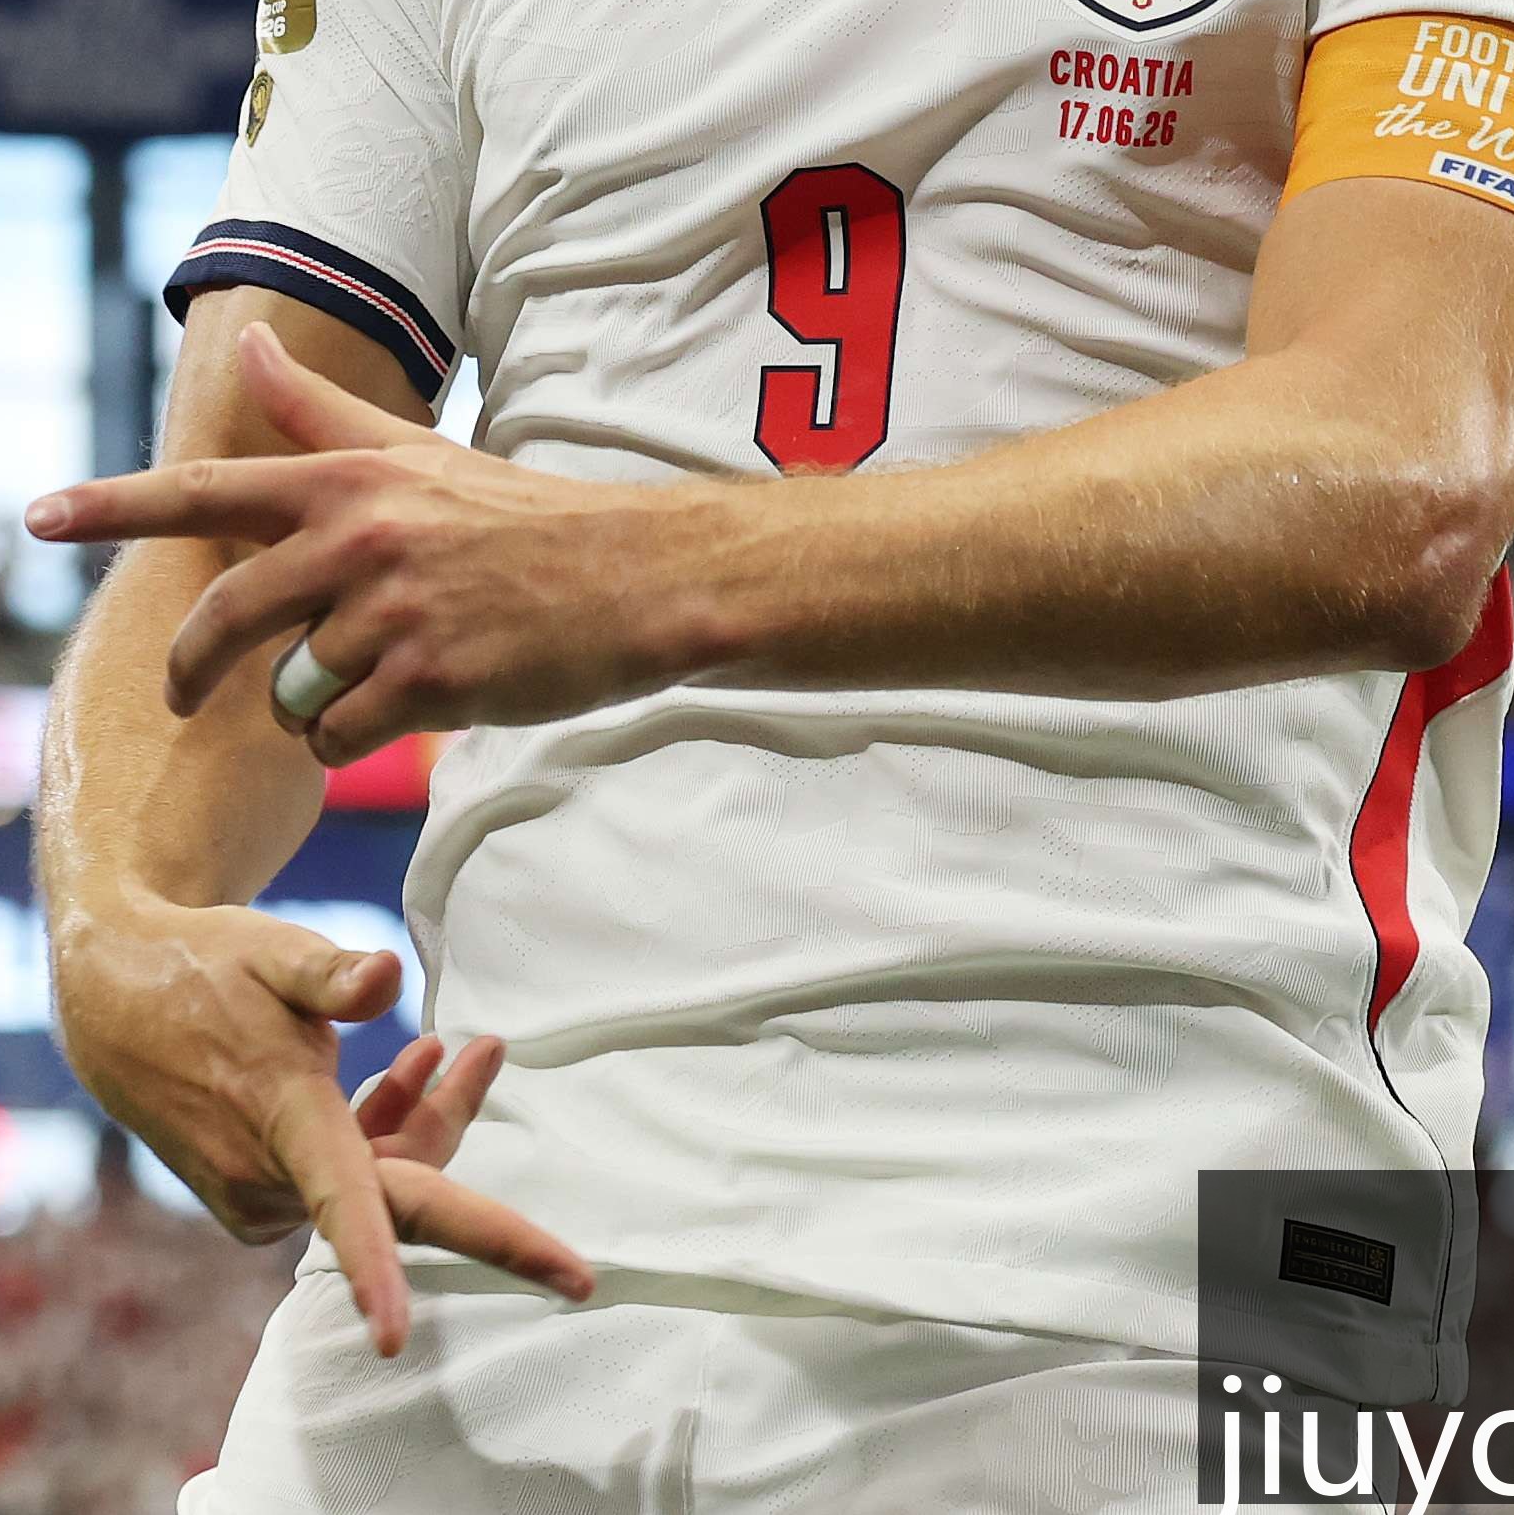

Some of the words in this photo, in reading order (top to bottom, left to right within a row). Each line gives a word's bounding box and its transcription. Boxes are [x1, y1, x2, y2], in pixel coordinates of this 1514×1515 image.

[1049, 50, 1193, 97] CROATIA
[1059, 100, 1177, 147] 17.06.26
[1374, 102, 1462, 141] the
[753, 162, 907, 477] 9
